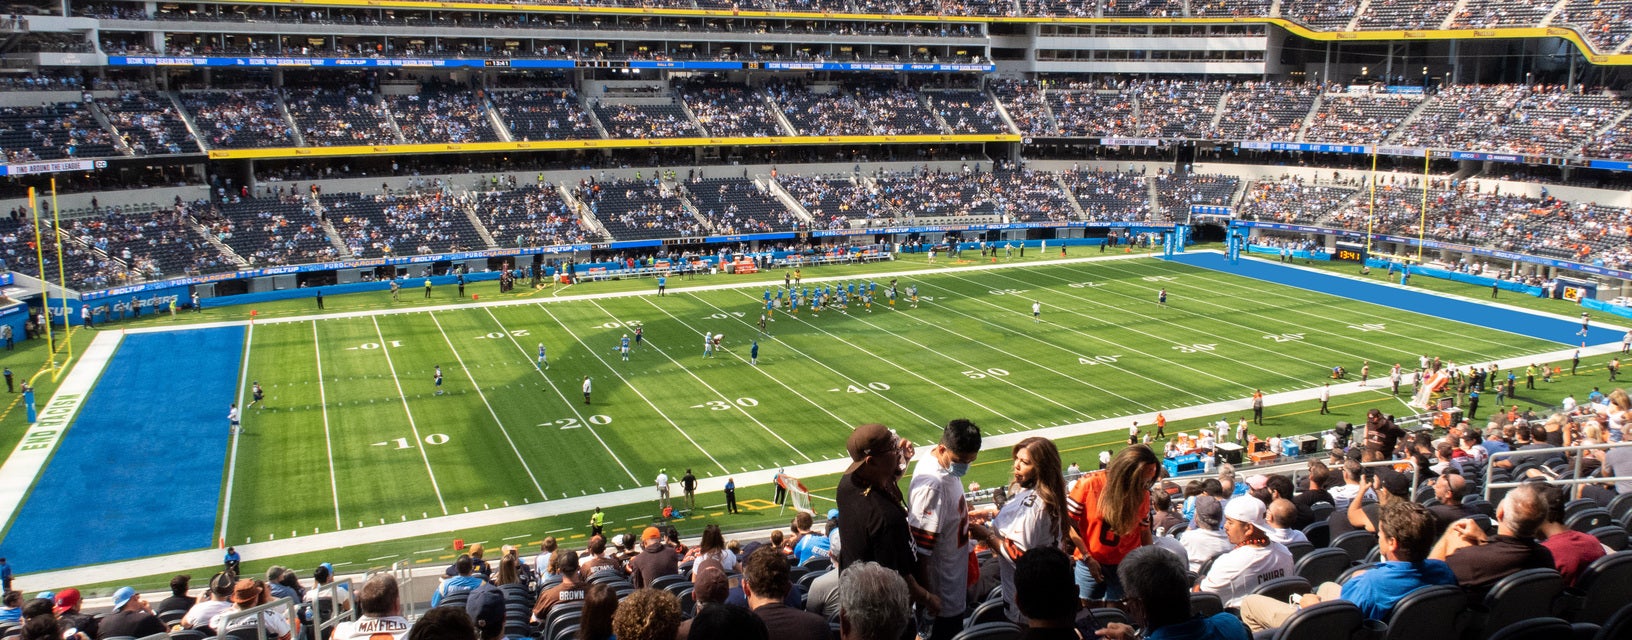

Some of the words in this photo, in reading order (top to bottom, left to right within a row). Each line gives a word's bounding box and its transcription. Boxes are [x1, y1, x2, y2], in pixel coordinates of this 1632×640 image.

[1340, 250, 1360, 260] 13:41
[1565, 288, 1577, 298] 25
[1078, 356, 1118, 365] 40
[961, 368, 1010, 378] 50
[846, 382, 890, 394] 40
[706, 397, 758, 410] 30
[37, 394, 80, 427] RACISM
[555, 414, 612, 430] 20
[20, 430, 57, 450] END
[391, 433, 449, 450] 10
[559, 590, 584, 600] BROWN
[358, 619, 407, 632] MAYFIELD
